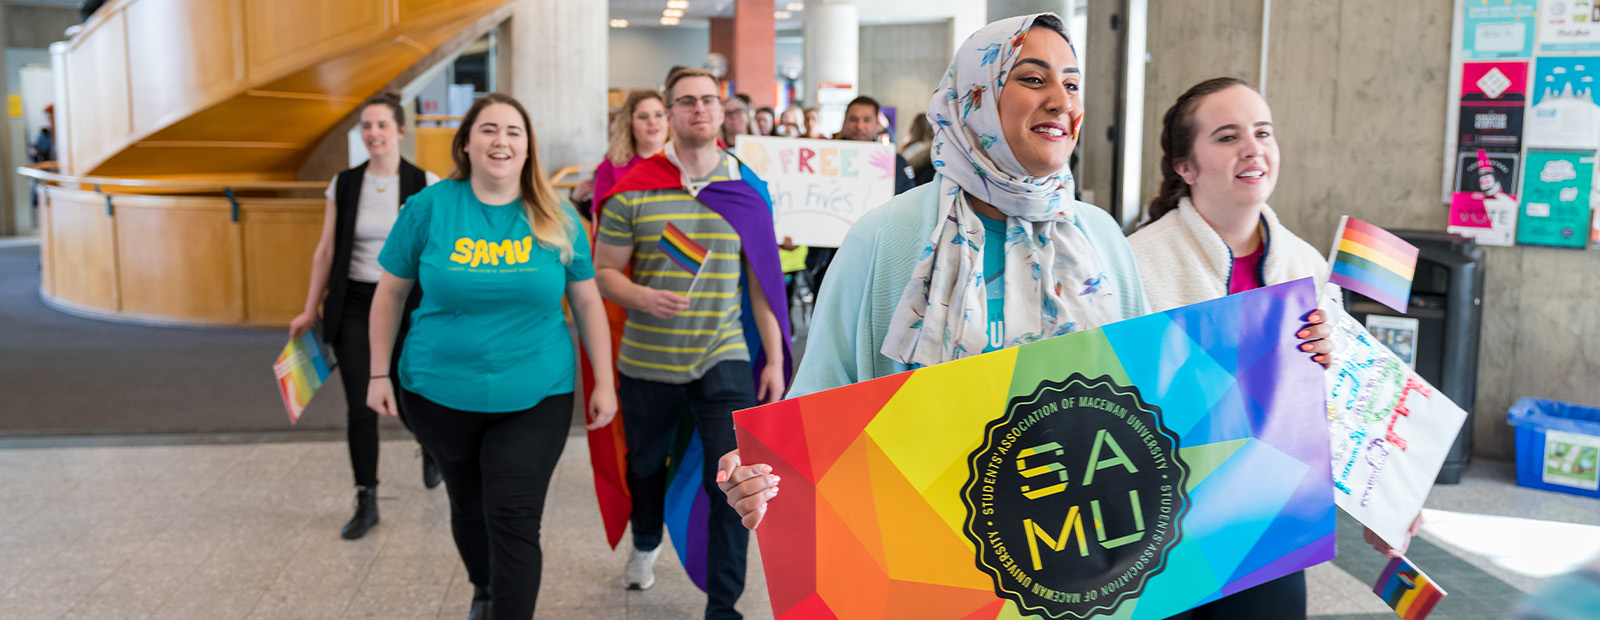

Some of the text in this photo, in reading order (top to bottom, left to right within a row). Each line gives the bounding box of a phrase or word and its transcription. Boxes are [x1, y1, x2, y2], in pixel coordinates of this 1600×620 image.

[779, 147, 859, 177] FREE
[450, 236, 532, 267] SAMU
[1000, 402, 1058, 455] ASSOCIATION
[1061, 397, 1075, 410] OF
[1079, 396, 1128, 419] MACEWAN
[1126, 414, 1169, 471] UNIVERSITY
[1326, 401, 1392, 507] 019
[987, 530, 1034, 588] UNIVERSITY
[1101, 543, 1158, 597] ASSOCIATION
[1031, 582, 1081, 604] MACEWAN
[1084, 589, 1098, 602] OF
